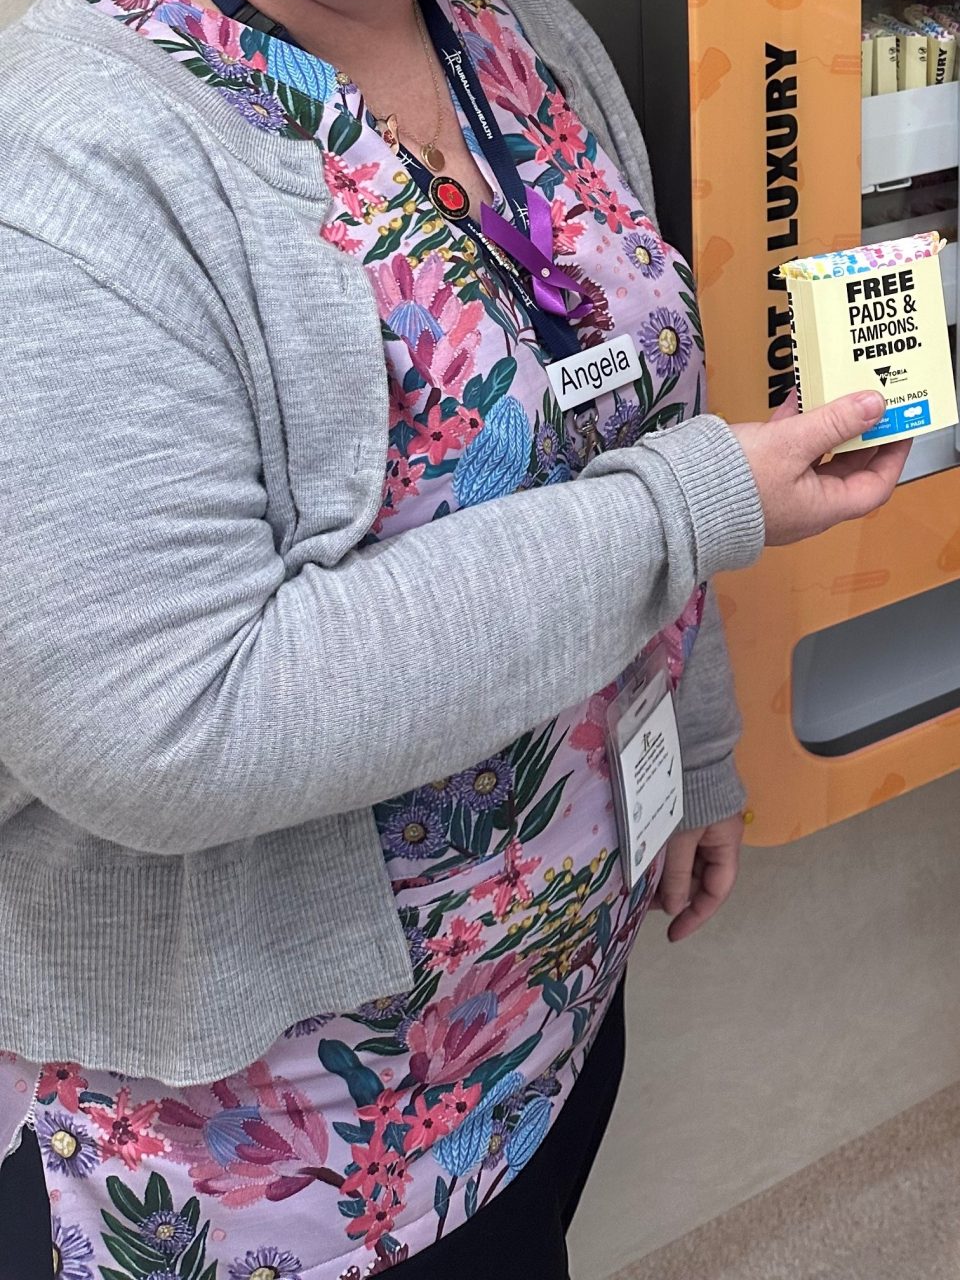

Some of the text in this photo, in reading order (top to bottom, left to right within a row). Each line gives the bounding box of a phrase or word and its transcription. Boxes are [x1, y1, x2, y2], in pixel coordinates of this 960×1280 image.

[935, 47, 948, 85] XURY
[455, 64, 470, 89] RURAL
[476, 110, 493, 140] HEALTH
[765, 41, 799, 252] LUXURY
[768, 256, 798, 291] A
[846, 269, 915, 303] FREE
[849, 294, 917, 326] PADS &
[850, 316, 918, 344] TAMPONS.
[767, 305, 797, 410] NOT
[853, 336, 922, 362] PERIOD.
[561, 348, 630, 395] Angela
[885, 389, 929, 407] THIN PADS
